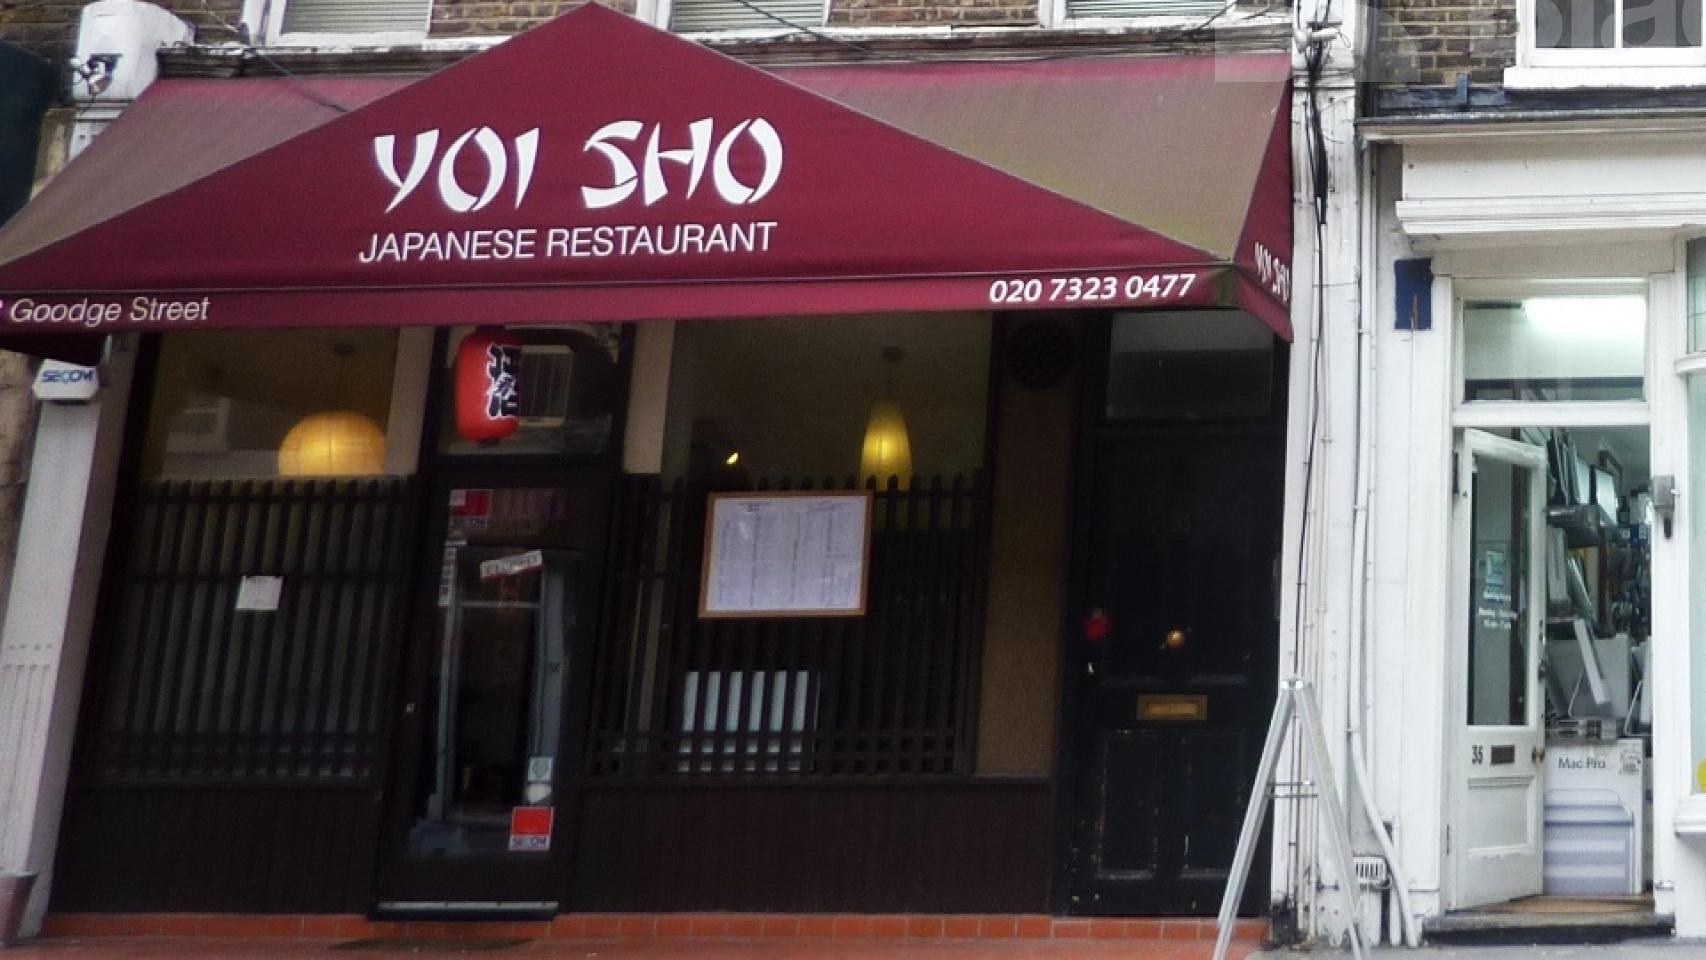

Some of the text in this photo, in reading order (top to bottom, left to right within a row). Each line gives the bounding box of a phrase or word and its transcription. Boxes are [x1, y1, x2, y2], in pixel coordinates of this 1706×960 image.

[374, 117, 783, 214] YOI SHO
[359, 222, 778, 264] JAPANESE RESTAURANT
[990, 273, 1197, 303] 020 7323 0477
[10, 296, 210, 328] Goodge Street
[42, 369, 94, 384] SECOM
[1471, 744, 1484, 765] 35
[1558, 756, 1583, 769] Mac
[1586, 756, 1607, 769] Pro
